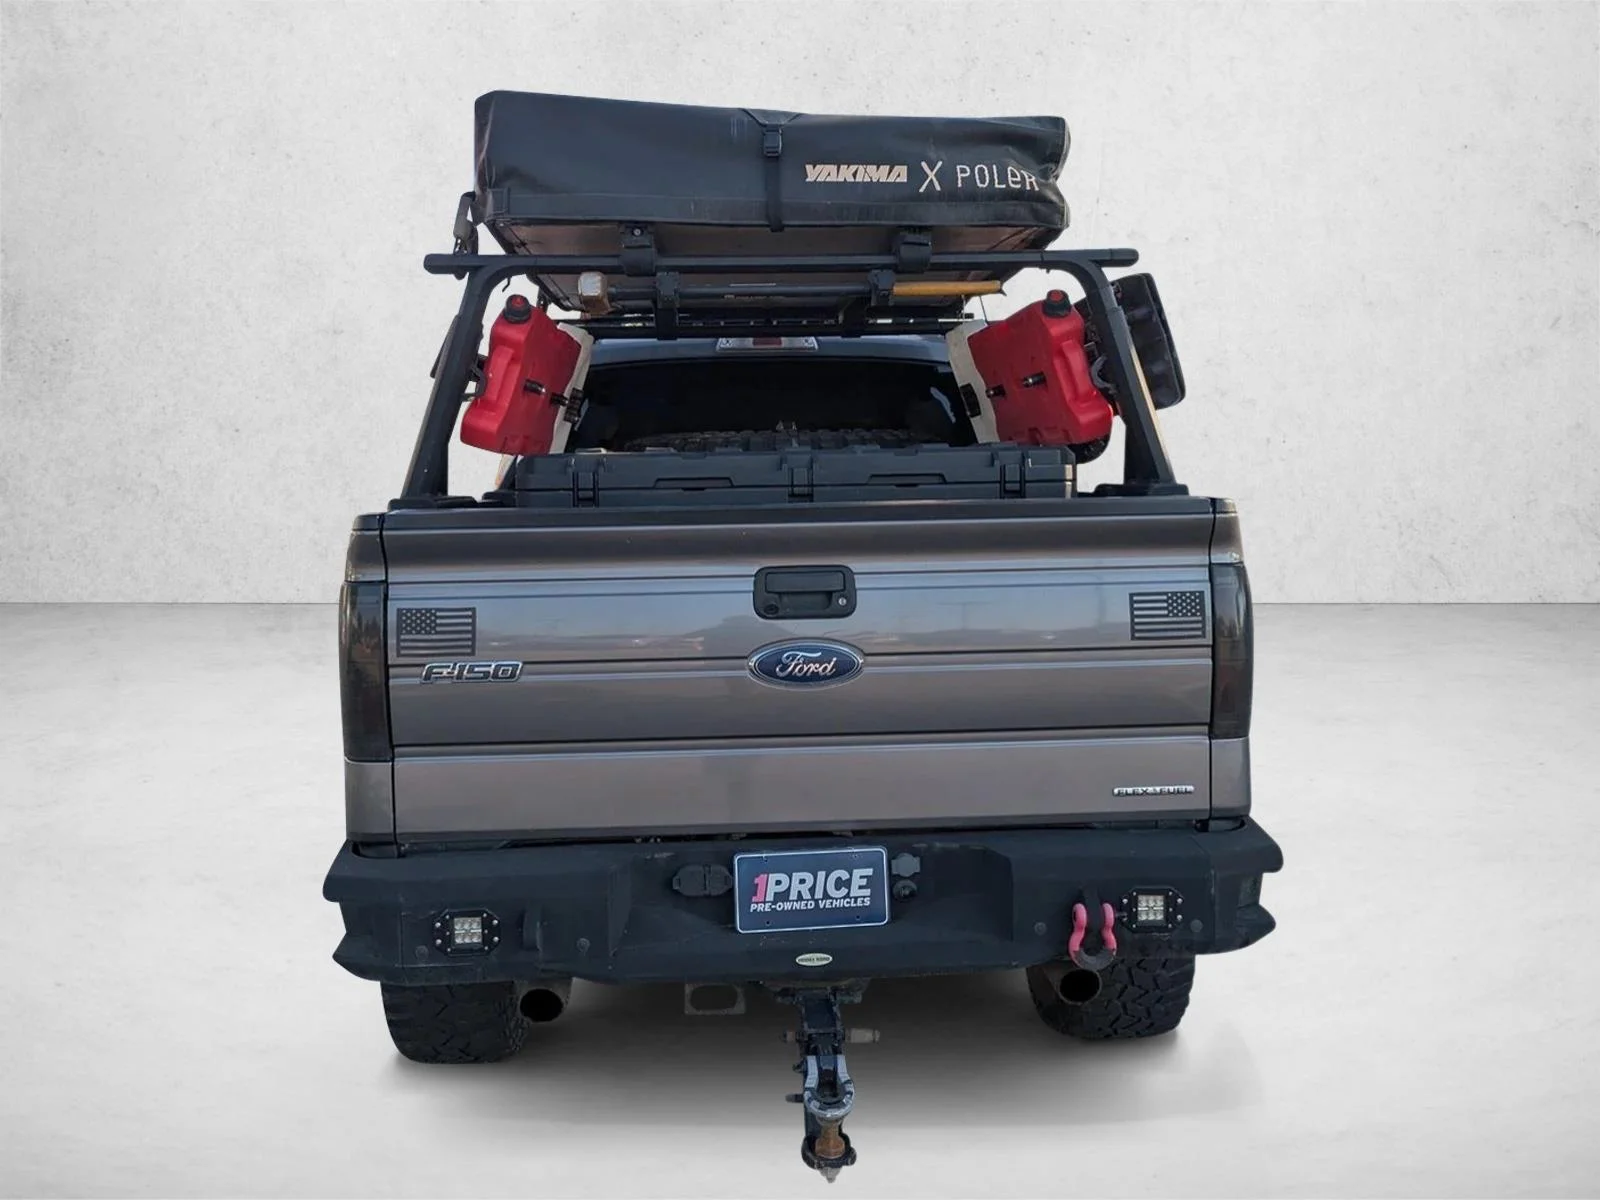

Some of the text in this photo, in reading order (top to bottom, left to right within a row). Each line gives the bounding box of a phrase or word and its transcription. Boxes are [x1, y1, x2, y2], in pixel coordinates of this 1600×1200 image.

[804, 164, 908, 183] YAKIMA
[919, 161, 943, 193] X
[421, 661, 525, 684] F-150
[775, 651, 837, 677] Ford
[750, 897, 871, 912] PRE-OWNED VEHICLES
